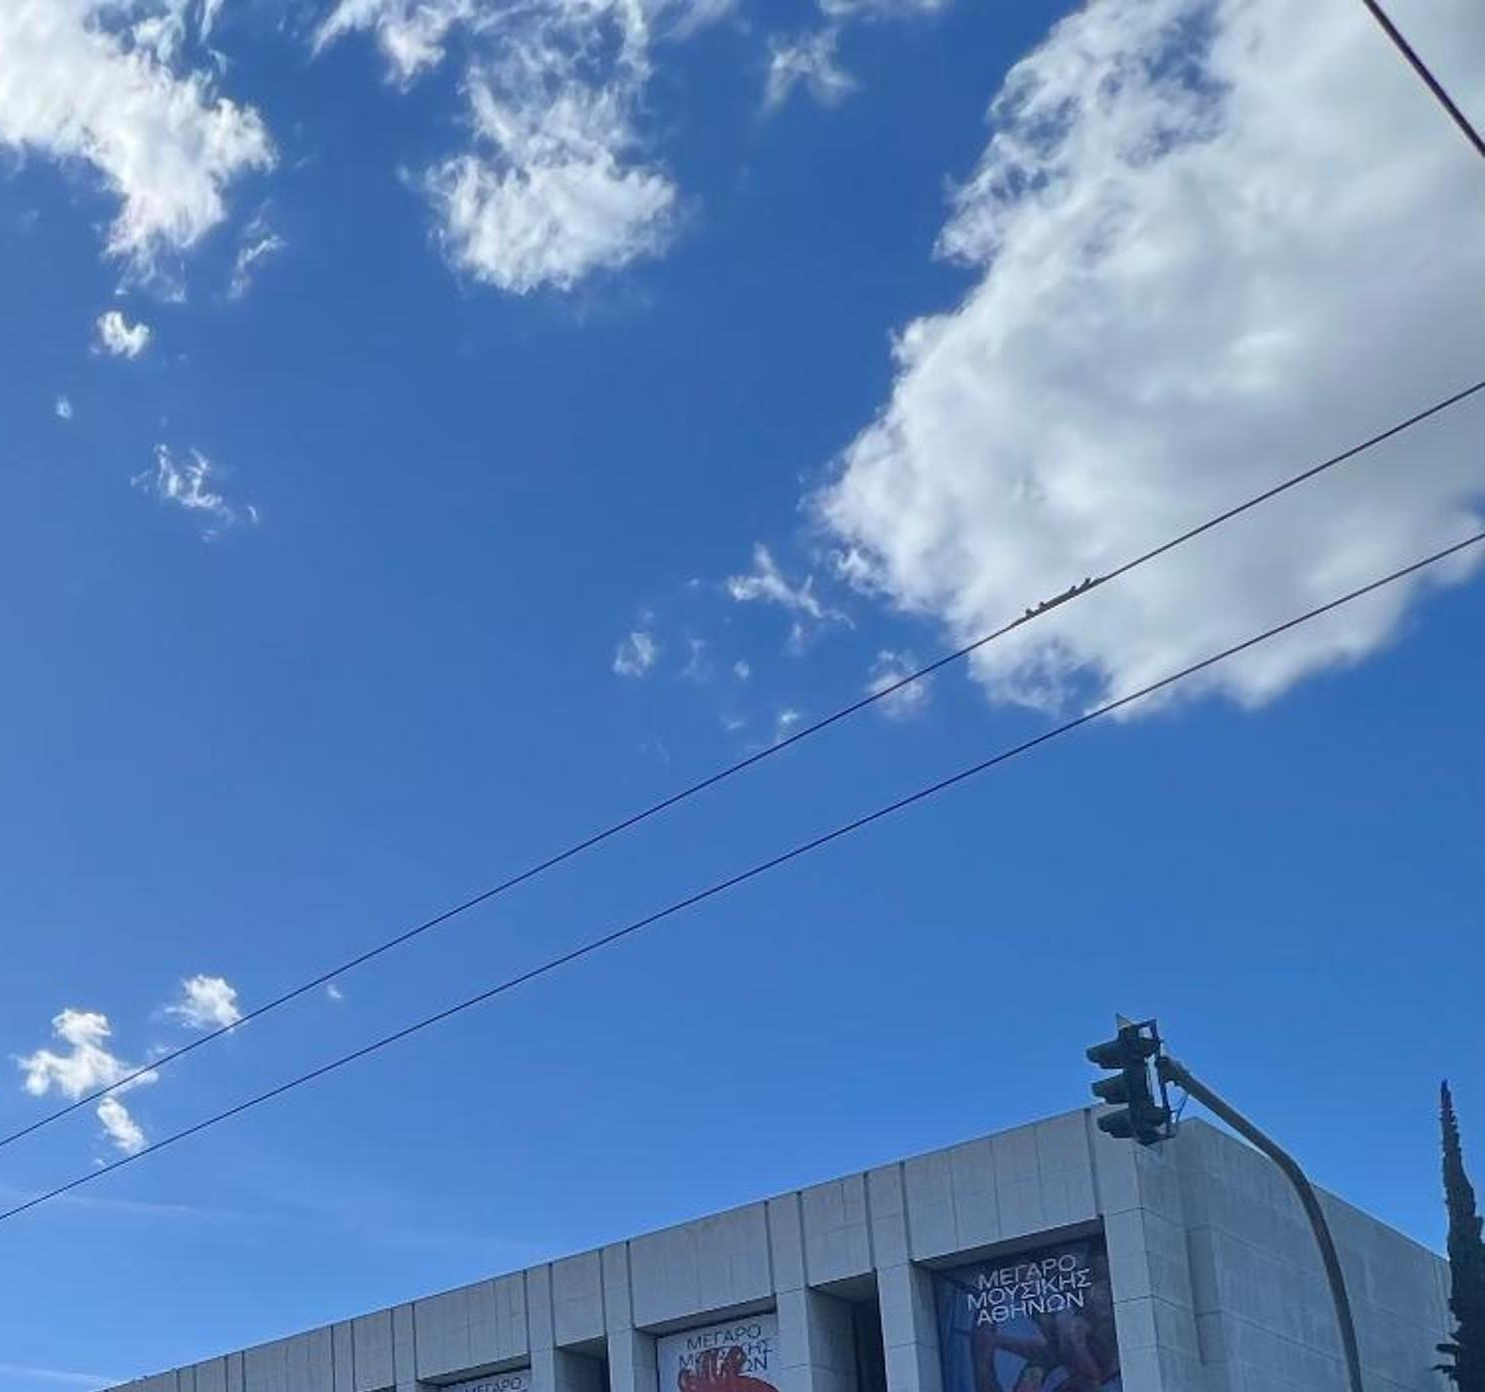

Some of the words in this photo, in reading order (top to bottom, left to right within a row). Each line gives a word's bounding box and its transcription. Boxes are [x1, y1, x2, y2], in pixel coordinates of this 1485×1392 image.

[967, 1268, 1092, 1311] ΜΟΥΣΙΚΗΣ
[977, 1254, 1077, 1290] ΜΕΓΑΡΟ
[977, 1289, 1085, 1327] ΑΘΗΝΩΝ
[687, 1324, 762, 1350] ΜΕΓΑΡΟ
